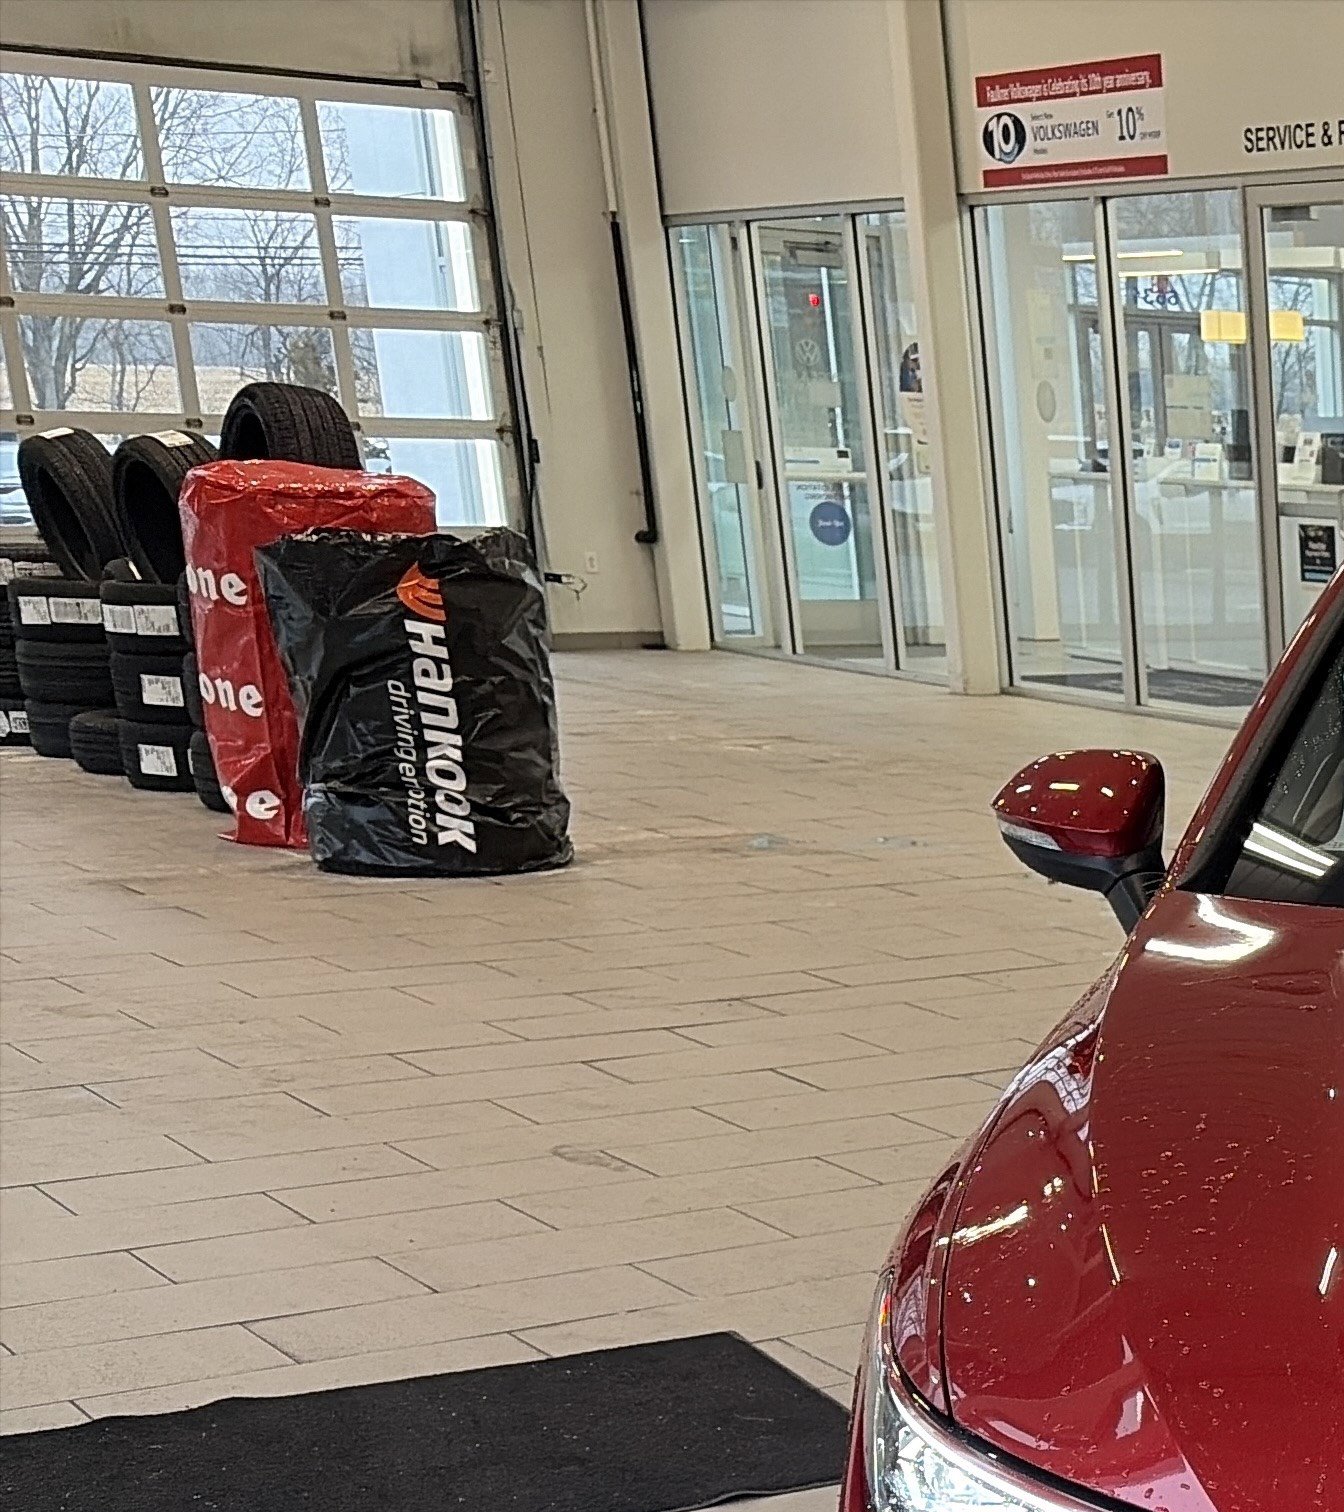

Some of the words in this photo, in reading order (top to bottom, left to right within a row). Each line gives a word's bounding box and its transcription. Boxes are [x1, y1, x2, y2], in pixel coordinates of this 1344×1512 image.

[987, 113, 1016, 159] 10
[1031, 120, 1100, 142] VOLKSWAGEN
[1243, 122, 1316, 153] SERVICE
[1321, 120, 1333, 147] &
[199, 673, 264, 717] one
[387, 680, 419, 763] driving
[403, 618, 477, 854] Hankook
